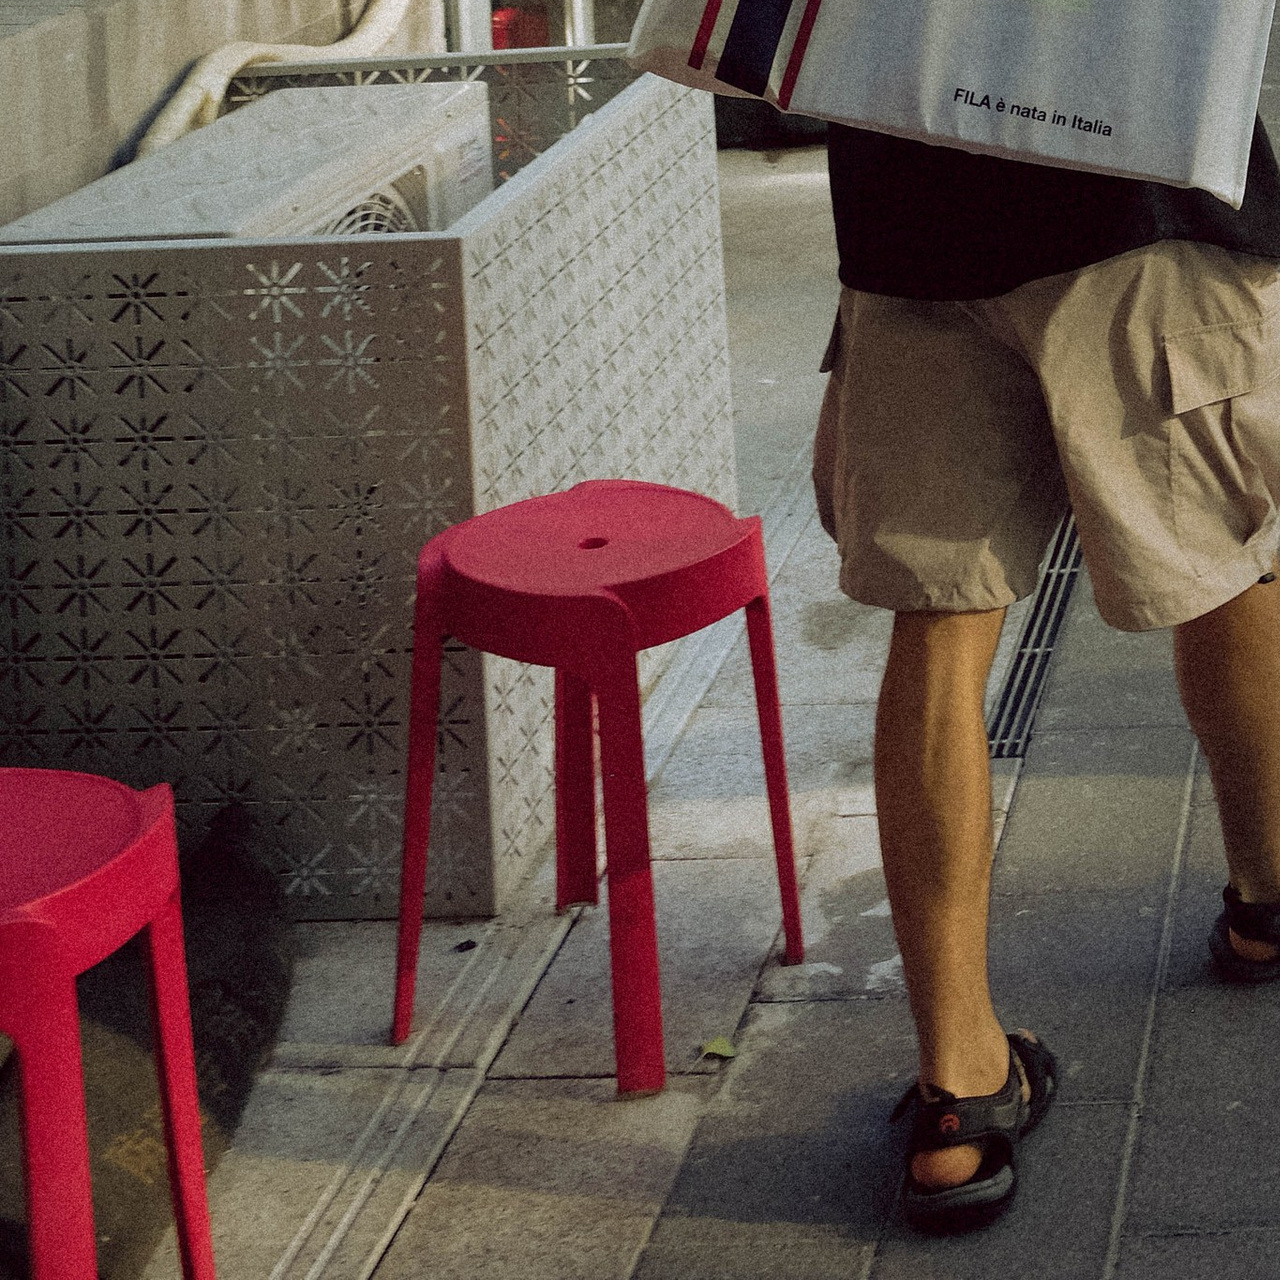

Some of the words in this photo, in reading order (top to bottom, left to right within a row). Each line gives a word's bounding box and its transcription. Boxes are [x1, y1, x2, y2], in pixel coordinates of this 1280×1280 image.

[953, 88, 991, 110] FILA
[995, 97, 1006, 112] è
[1010, 104, 1047, 122] nata
[1052, 110, 1067, 126] in
[1071, 114, 1113, 137] Italia
